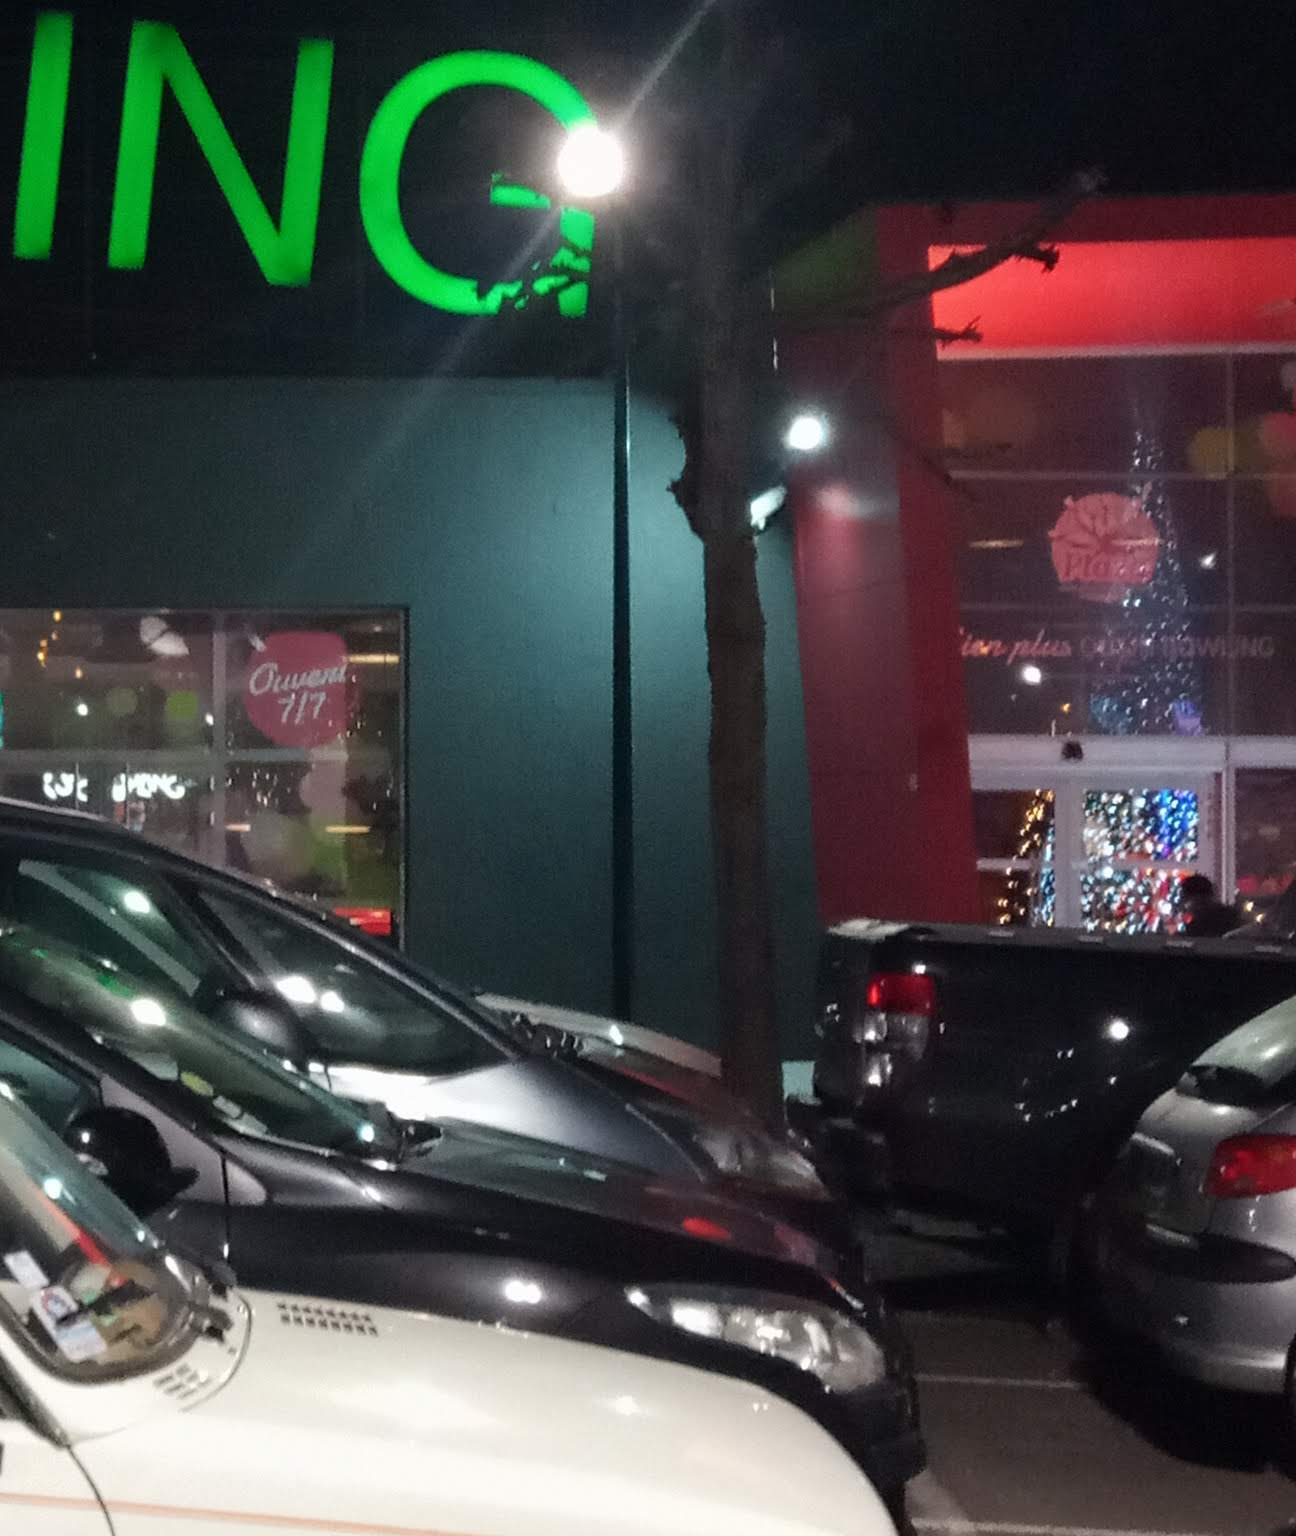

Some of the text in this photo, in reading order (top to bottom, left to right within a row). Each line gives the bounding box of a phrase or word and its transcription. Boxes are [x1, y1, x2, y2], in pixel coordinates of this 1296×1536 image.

[958, 627, 1007, 658] ien
[1005, 628, 1072, 666] plus
[277, 690, 327, 725] 7/7
